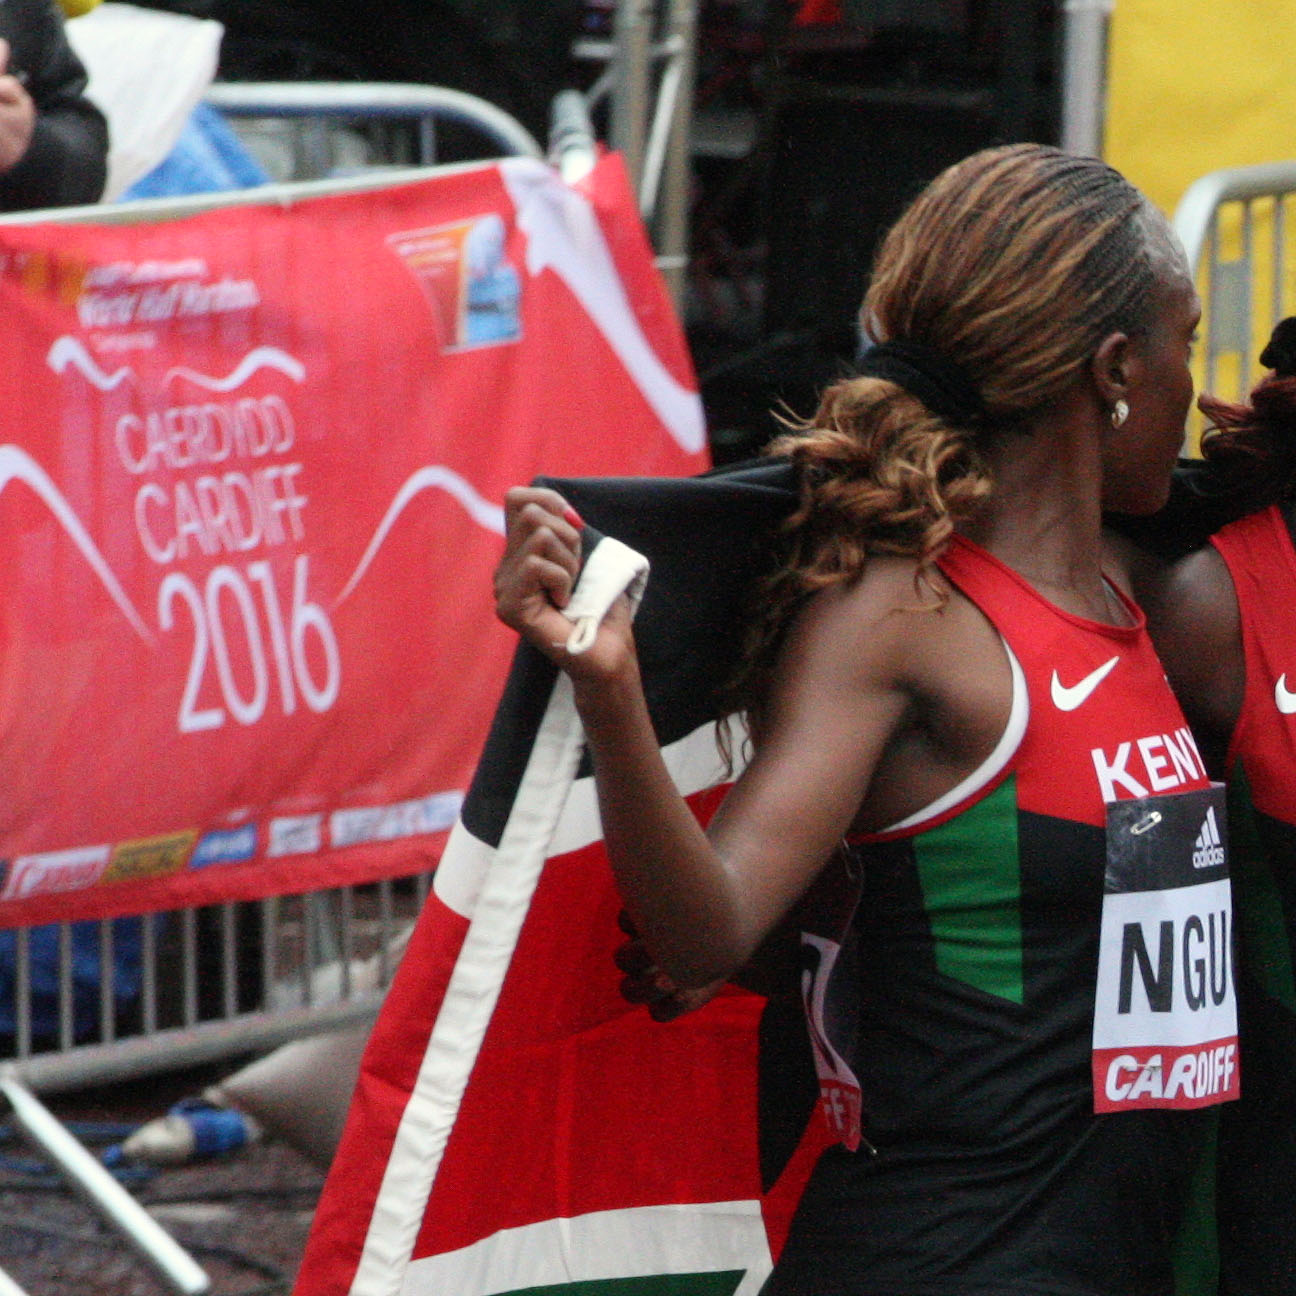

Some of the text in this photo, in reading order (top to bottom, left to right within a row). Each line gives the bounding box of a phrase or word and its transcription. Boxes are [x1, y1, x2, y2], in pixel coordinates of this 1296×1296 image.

[135, 462, 308, 564] CARDIFF
[157, 554, 341, 733] 2016
[1192, 846, 1225, 870] adidas
[1104, 1044, 1236, 1102] CARDIFF
